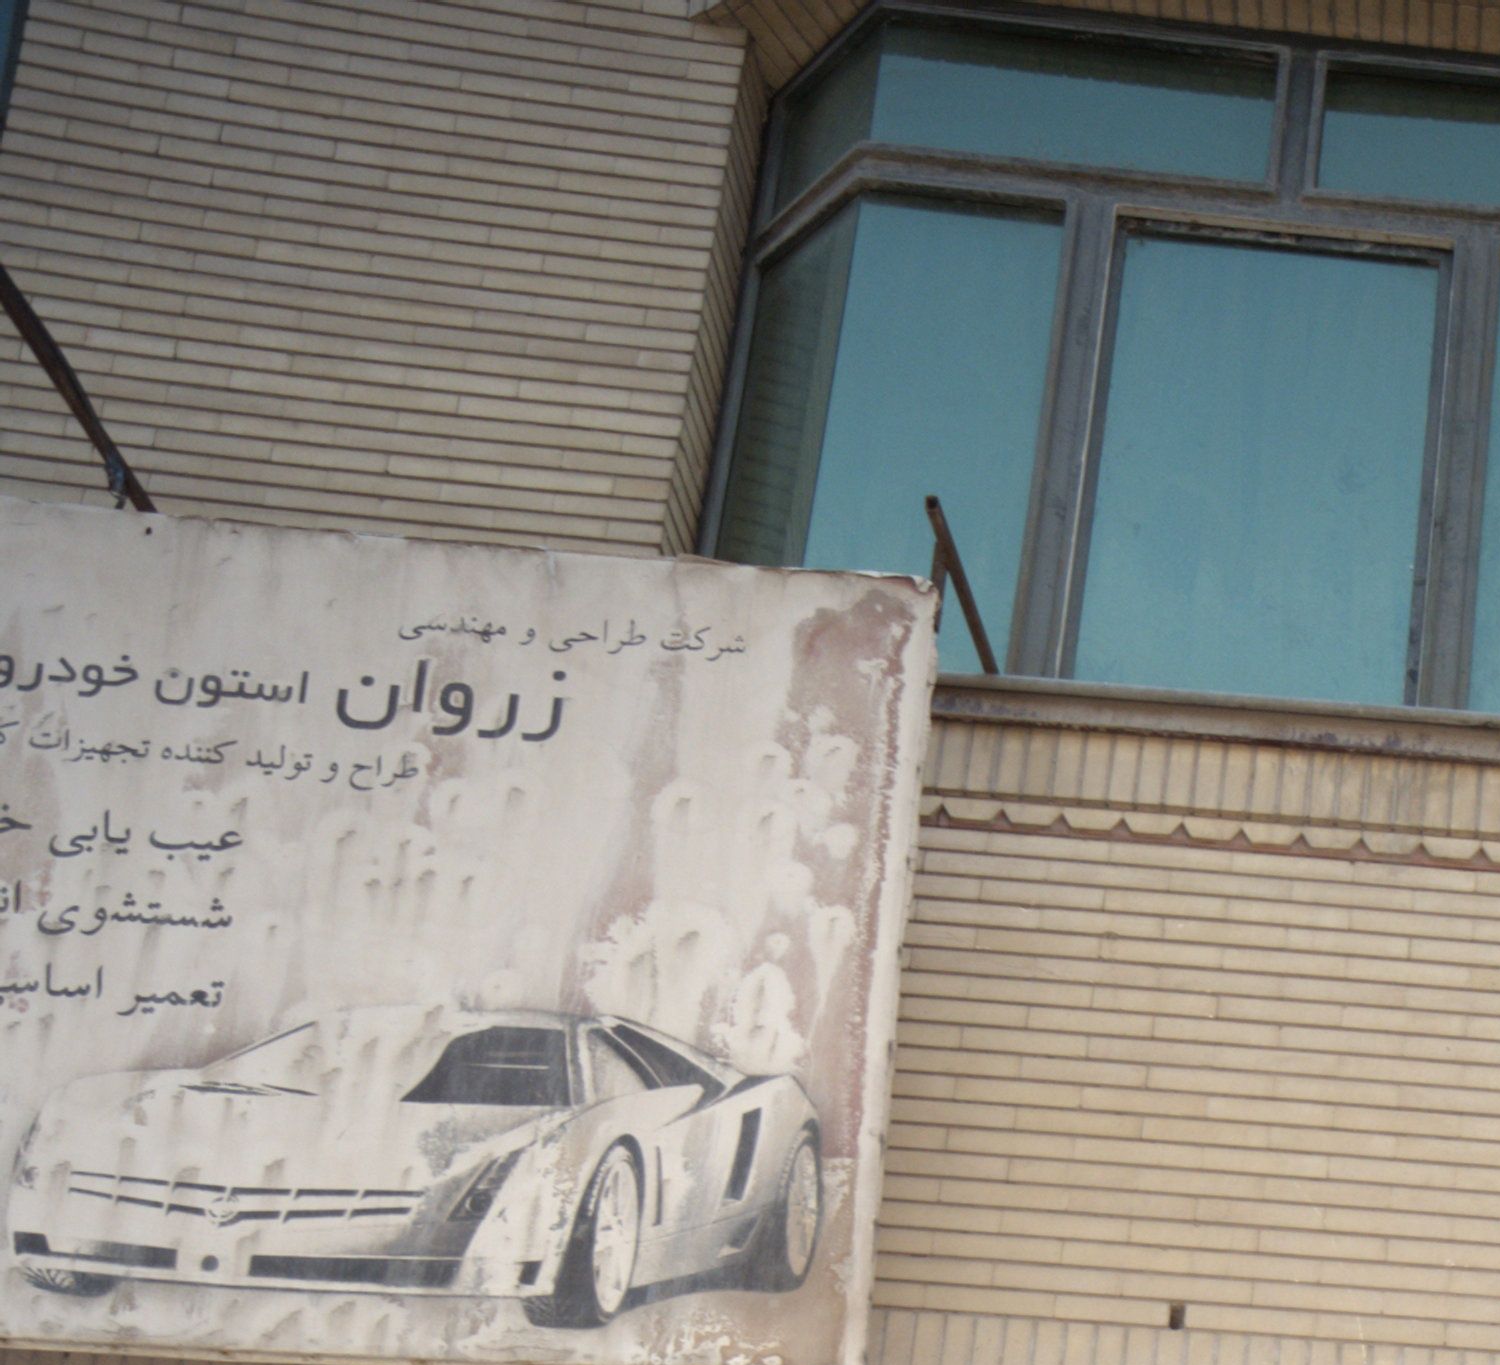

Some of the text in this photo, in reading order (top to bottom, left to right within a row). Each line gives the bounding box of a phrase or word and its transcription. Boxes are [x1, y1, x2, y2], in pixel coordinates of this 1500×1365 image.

[398, 617, 746, 661] شرکت طراحی و مهندسی
[154, 668, 310, 708] استون
[336, 658, 567, 742] زروان
[29, 729, 150, 764] تجهیزات
[160, 740, 238, 765] کننده
[245, 744, 312, 781] تولید
[320, 761, 339, 783] و
[348, 755, 419, 790] طراح
[49, 809, 131, 858] یابی
[149, 830, 243, 861] عیب
[37, 892, 233, 936] شستشوی
[0, 962, 225, 1016] تعمیر اساس
